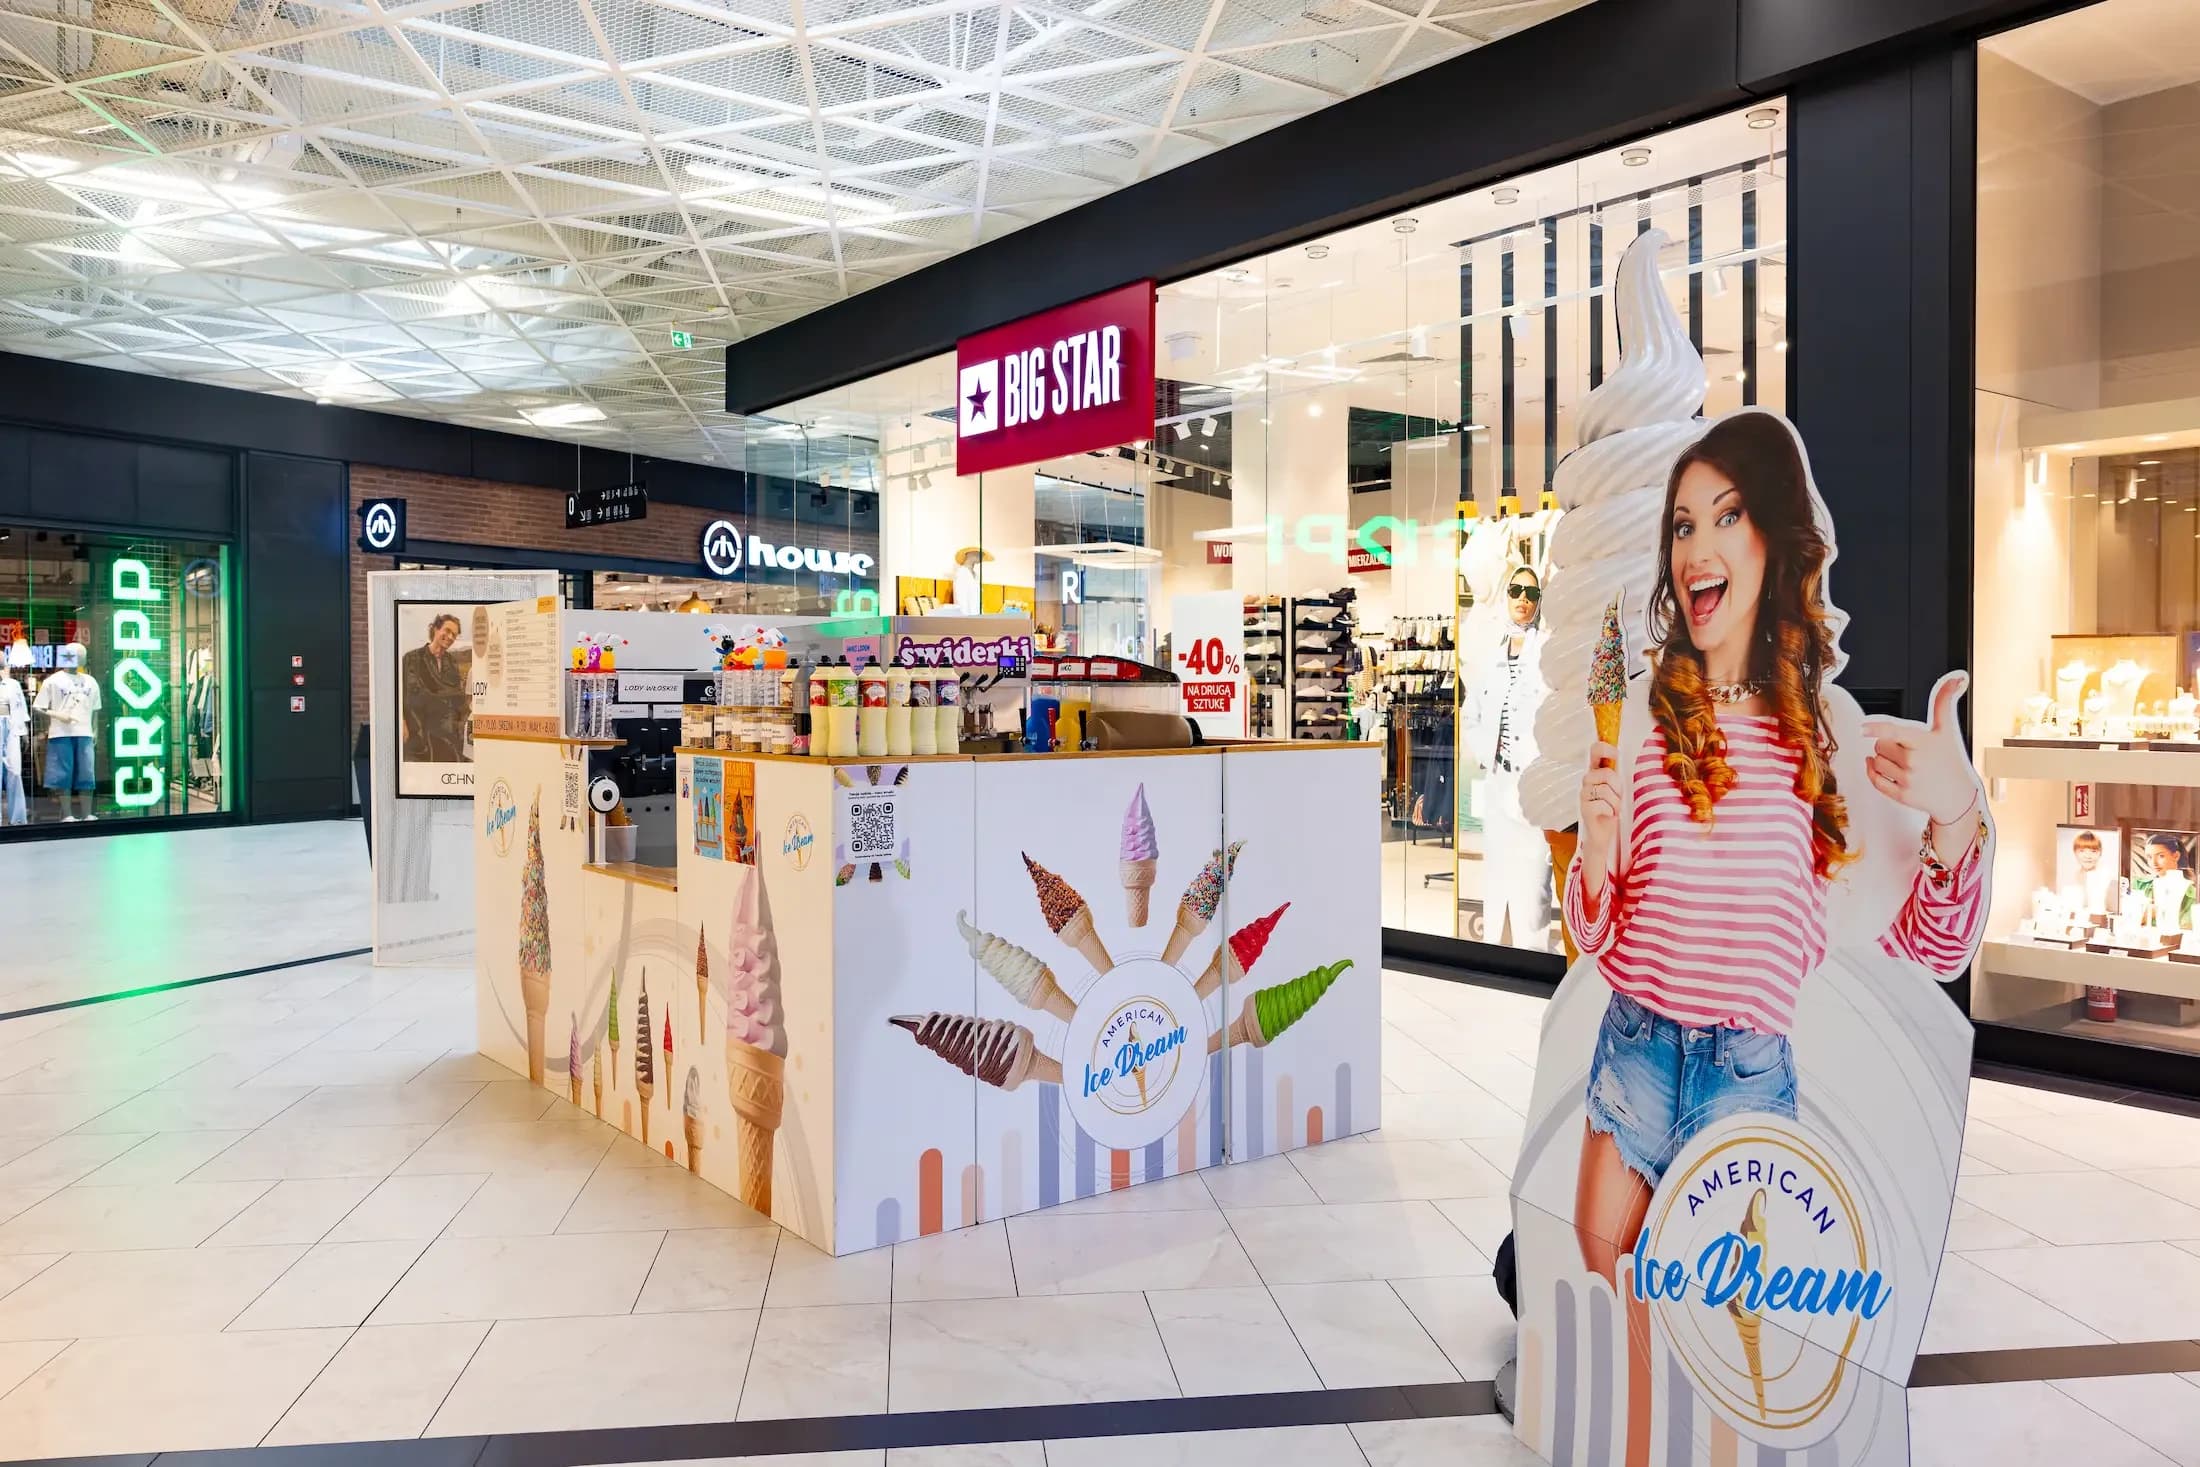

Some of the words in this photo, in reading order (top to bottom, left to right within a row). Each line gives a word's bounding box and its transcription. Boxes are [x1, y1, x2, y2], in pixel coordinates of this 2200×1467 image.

[1004, 347, 1045, 427] BIG
[1052, 325, 1121, 415] STAR
[748, 535, 874, 577] house
[112, 558, 165, 807] CROPP
[1178, 637, 1240, 675] -40%
[1187, 685, 1200, 696] NA
[1201, 684, 1232, 698] DRUGĄ
[1193, 698, 1225, 712] SZTUKĘ
[1102, 1008, 1165, 1048] AMERICAN
[1083, 1063, 1114, 1098] Ice
[1114, 1026, 1188, 1078] Dream
[1687, 1159, 1836, 1235] AMERICAN
[1633, 1227, 1692, 1302] Ice
[1696, 1231, 1893, 1321] Dream
